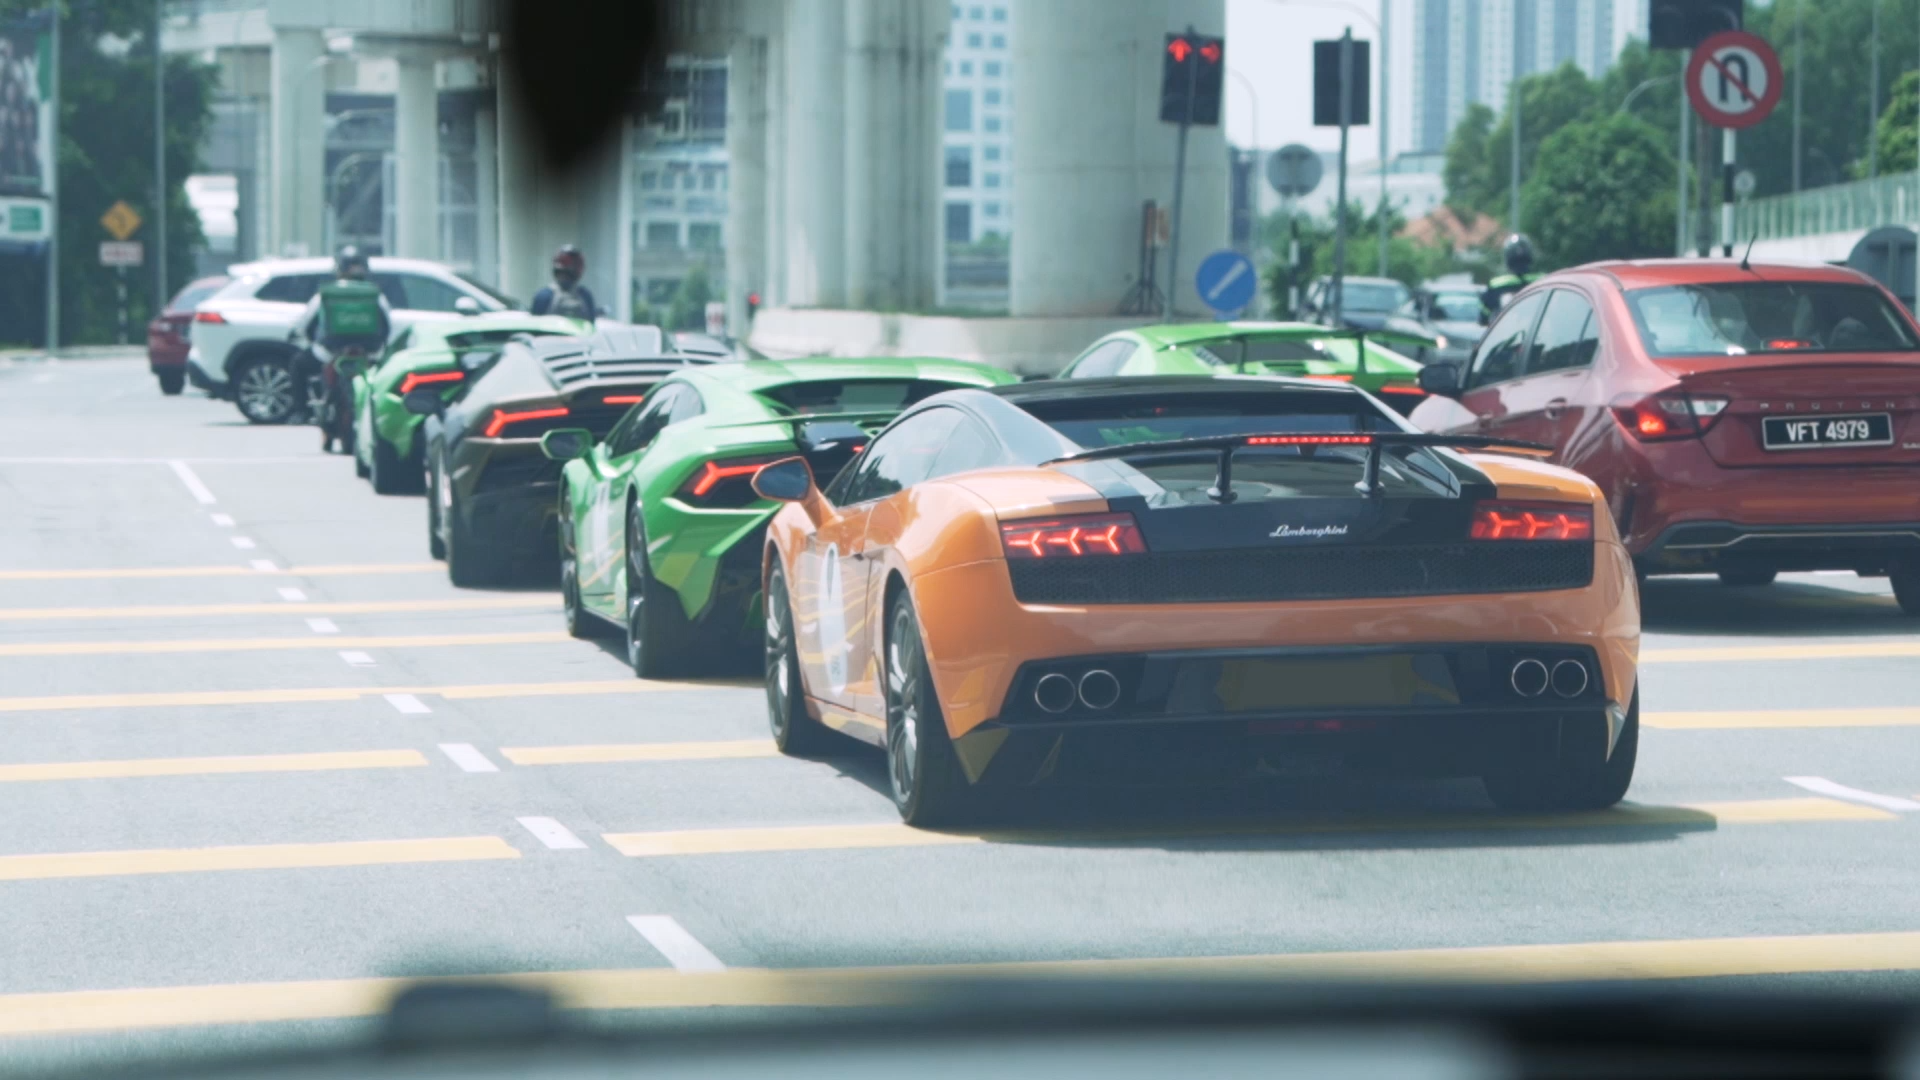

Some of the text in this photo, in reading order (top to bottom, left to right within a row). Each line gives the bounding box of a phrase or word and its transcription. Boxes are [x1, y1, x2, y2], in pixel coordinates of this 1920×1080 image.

[1786, 419, 1870, 442] VFT 4979
[1268, 524, 1348, 538] Lamborghini
